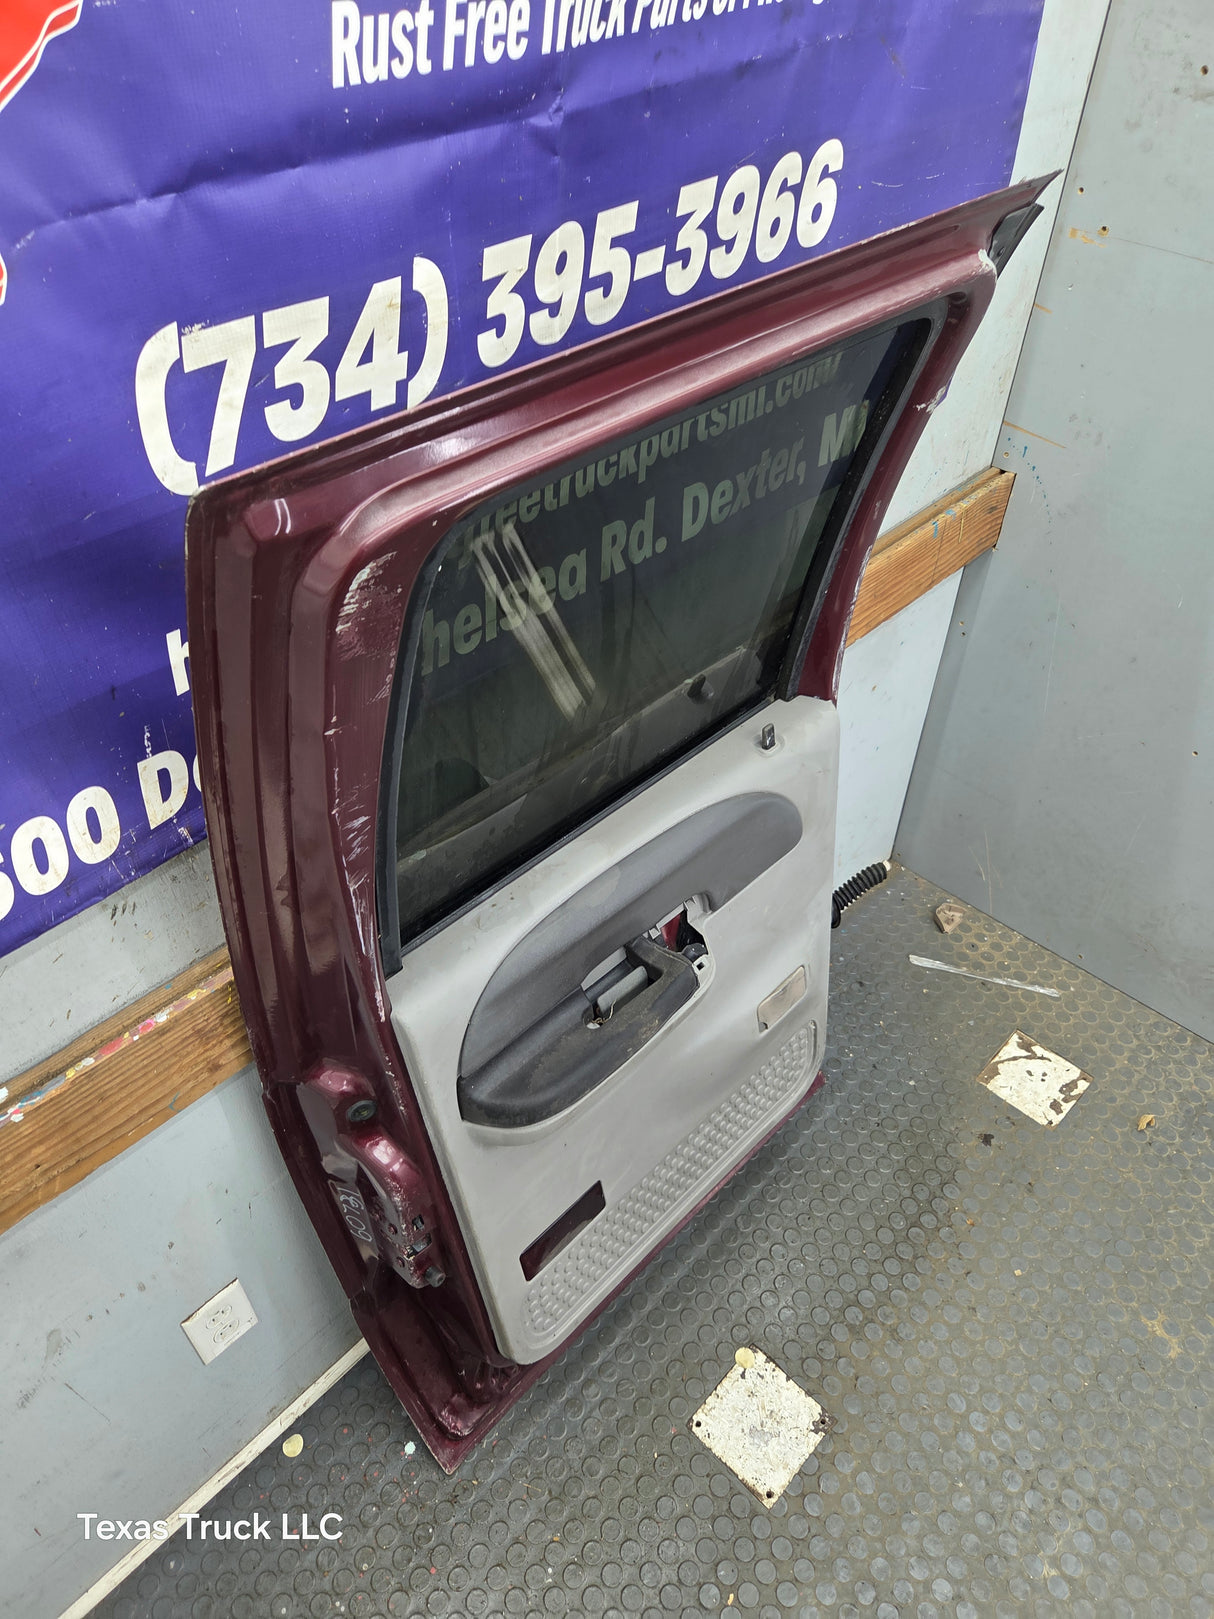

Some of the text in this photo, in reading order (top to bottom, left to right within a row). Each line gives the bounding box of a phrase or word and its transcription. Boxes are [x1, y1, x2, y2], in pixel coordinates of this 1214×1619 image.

[332, 0, 434, 88] Rust
[443, 0, 530, 71] Free
[135, 138, 844, 495] (734) 395-3966
[0, 785, 121, 922] 00
[601, 496, 668, 582] Rd.
[682, 437, 806, 542] Dexter,
